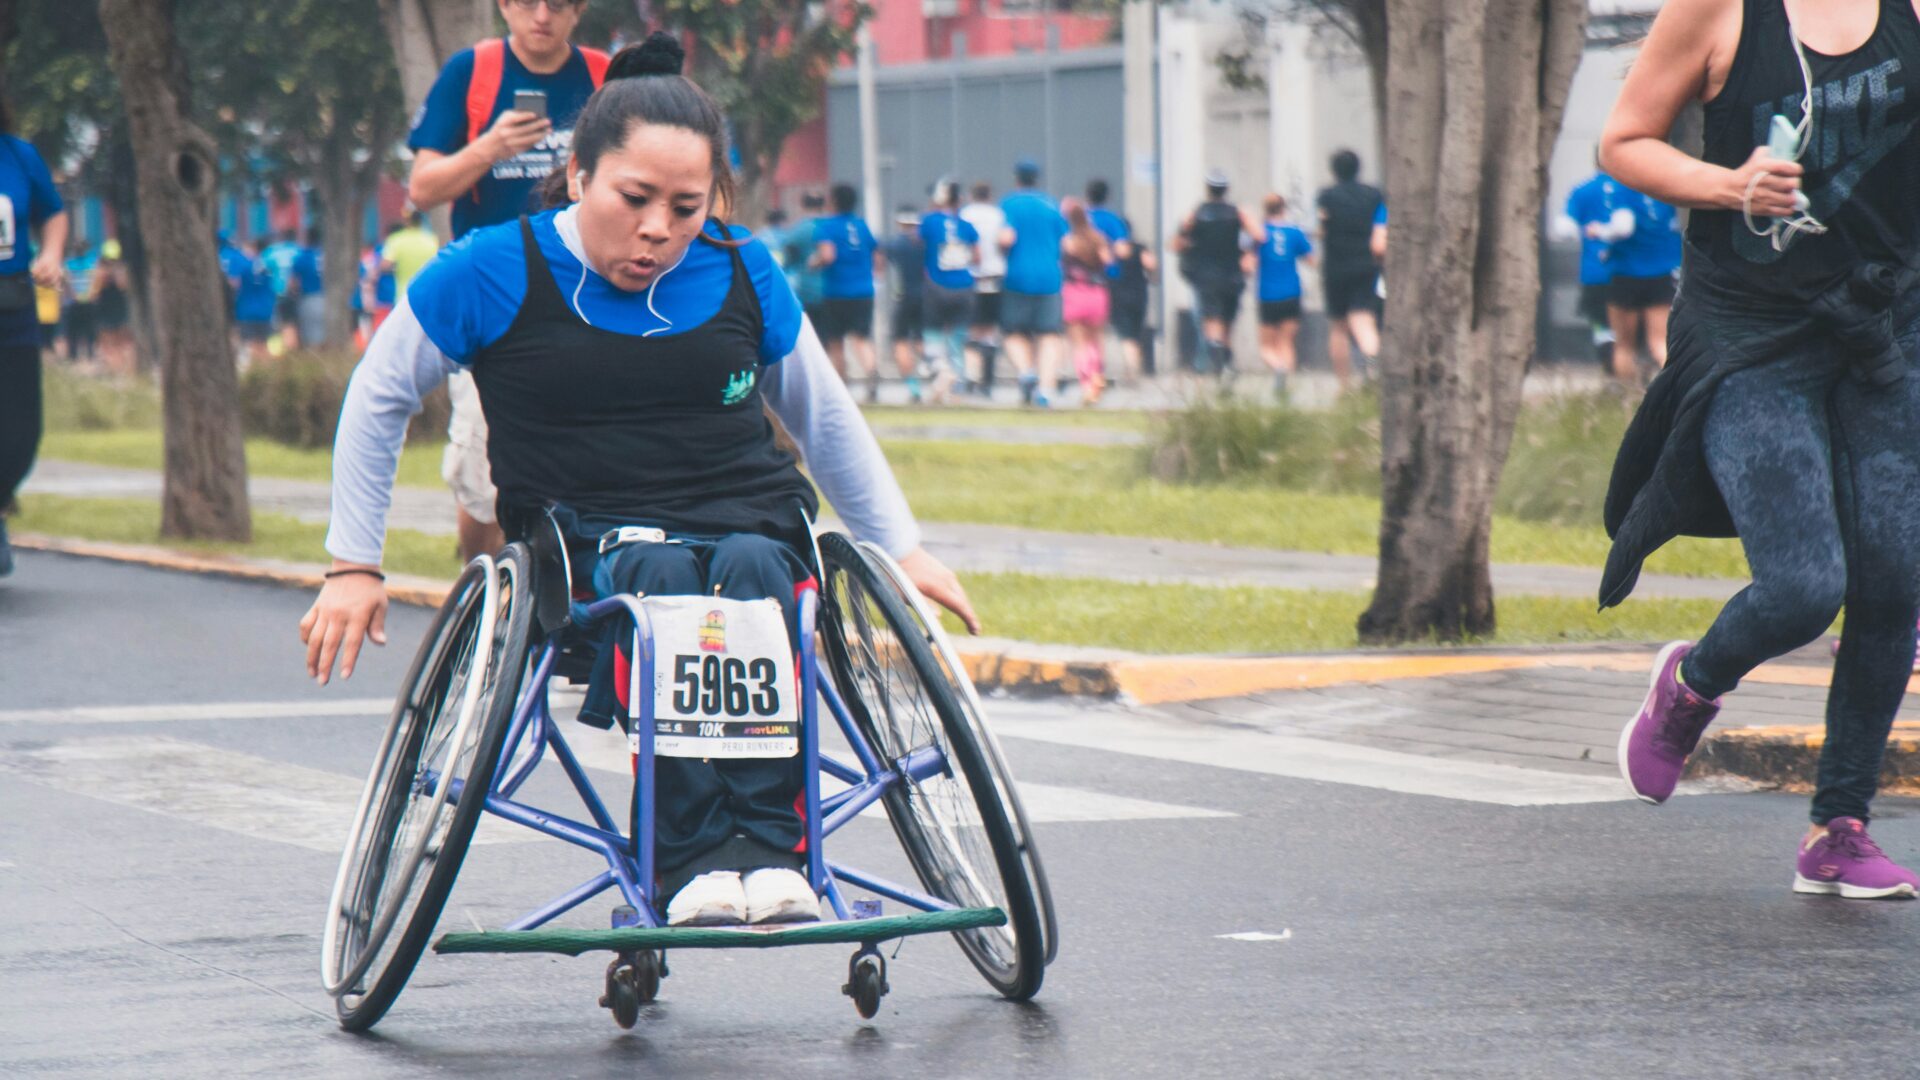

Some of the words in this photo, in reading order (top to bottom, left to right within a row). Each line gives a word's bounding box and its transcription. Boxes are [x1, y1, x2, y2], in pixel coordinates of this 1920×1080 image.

[672, 654, 780, 717] 5963
[698, 722, 725, 738] 10K
[721, 742, 744, 753] PERU
[746, 742, 785, 752] RUNNERS
